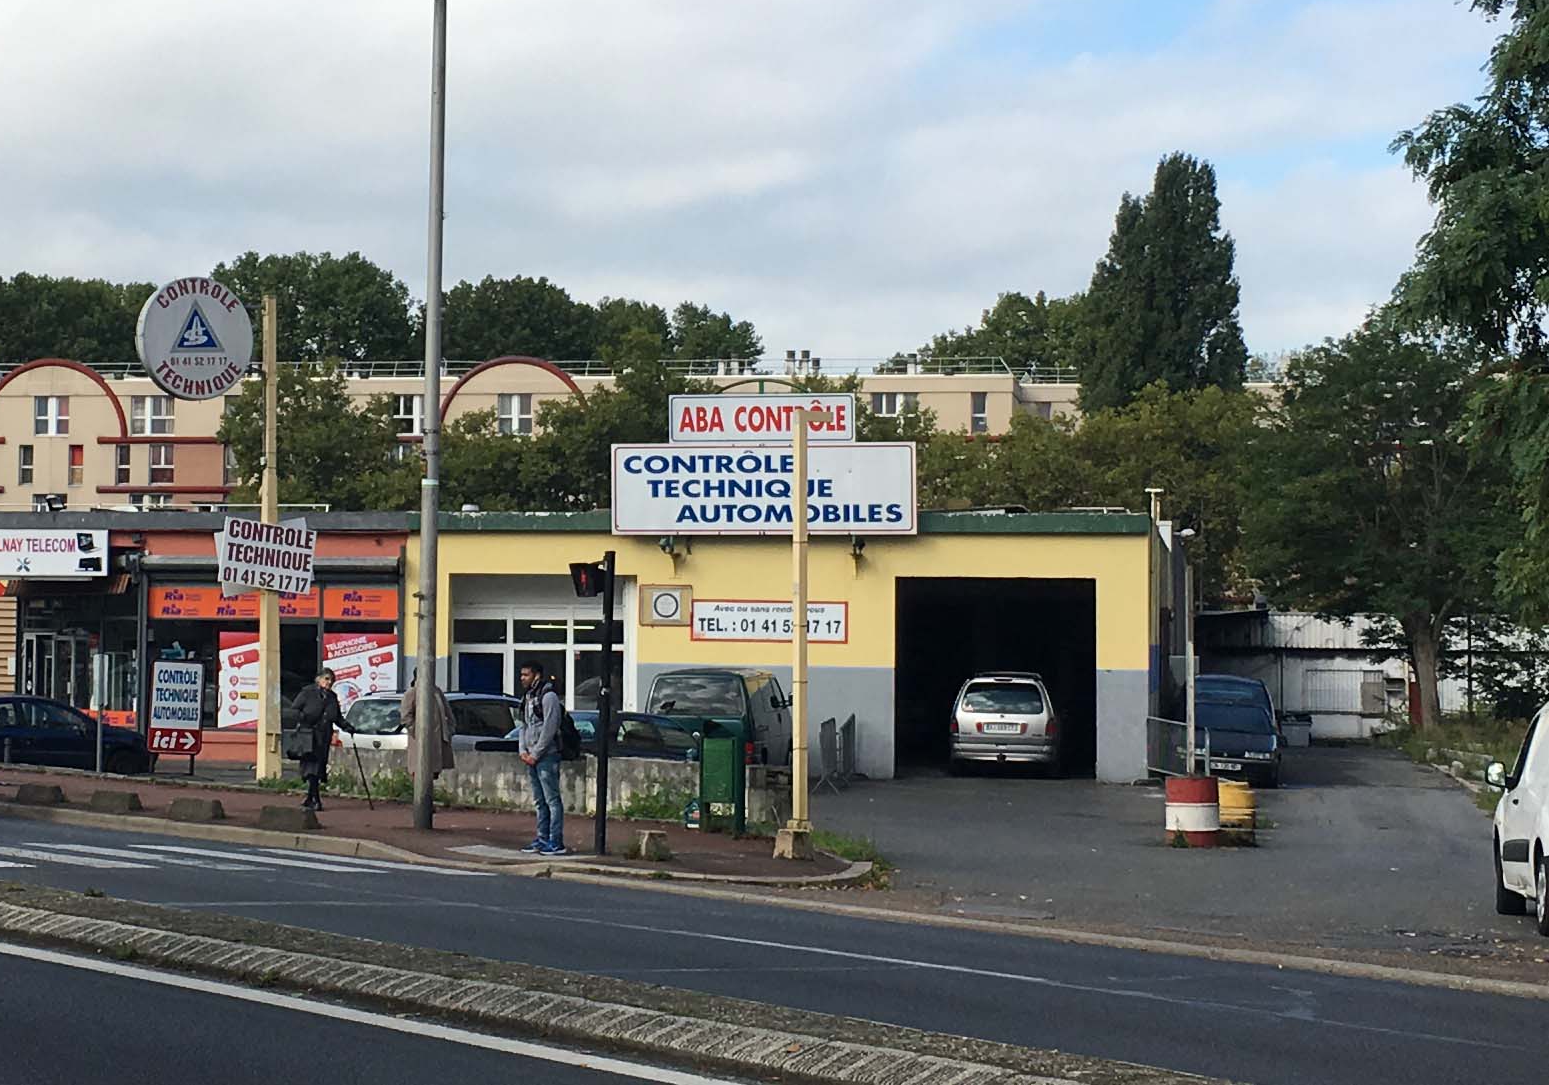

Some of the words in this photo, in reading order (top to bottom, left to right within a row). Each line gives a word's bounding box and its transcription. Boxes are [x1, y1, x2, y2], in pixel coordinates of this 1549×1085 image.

[157, 278, 239, 312] CONTROLE
[156, 360, 242, 395] TECHNIQUE
[679, 406, 724, 432] ABA
[733, 400, 846, 432] CONTÔLE
[623, 450, 794, 474] CONTRÔLE
[676, 504, 903, 523] AUTOMOBILES
[229, 519, 314, 549] CONTROLE
[26, 538, 76, 553] TELECOM
[228, 542, 312, 572] TECHNIQUE
[224, 567, 238, 583] 01
[241, 569, 256, 585] 41
[259, 572, 275, 588] 52
[278, 575, 293, 590] 17
[295, 577, 309, 592] 17
[714, 604, 735, 613] Avec
[740, 618, 756, 632] 01
[761, 619, 777, 633] 41
[825, 620, 841, 634] 17
[156, 687, 199, 703] TECHNIQUE
[154, 705, 199, 722] AUTOMOBILES
[152, 730, 178, 749] ici
